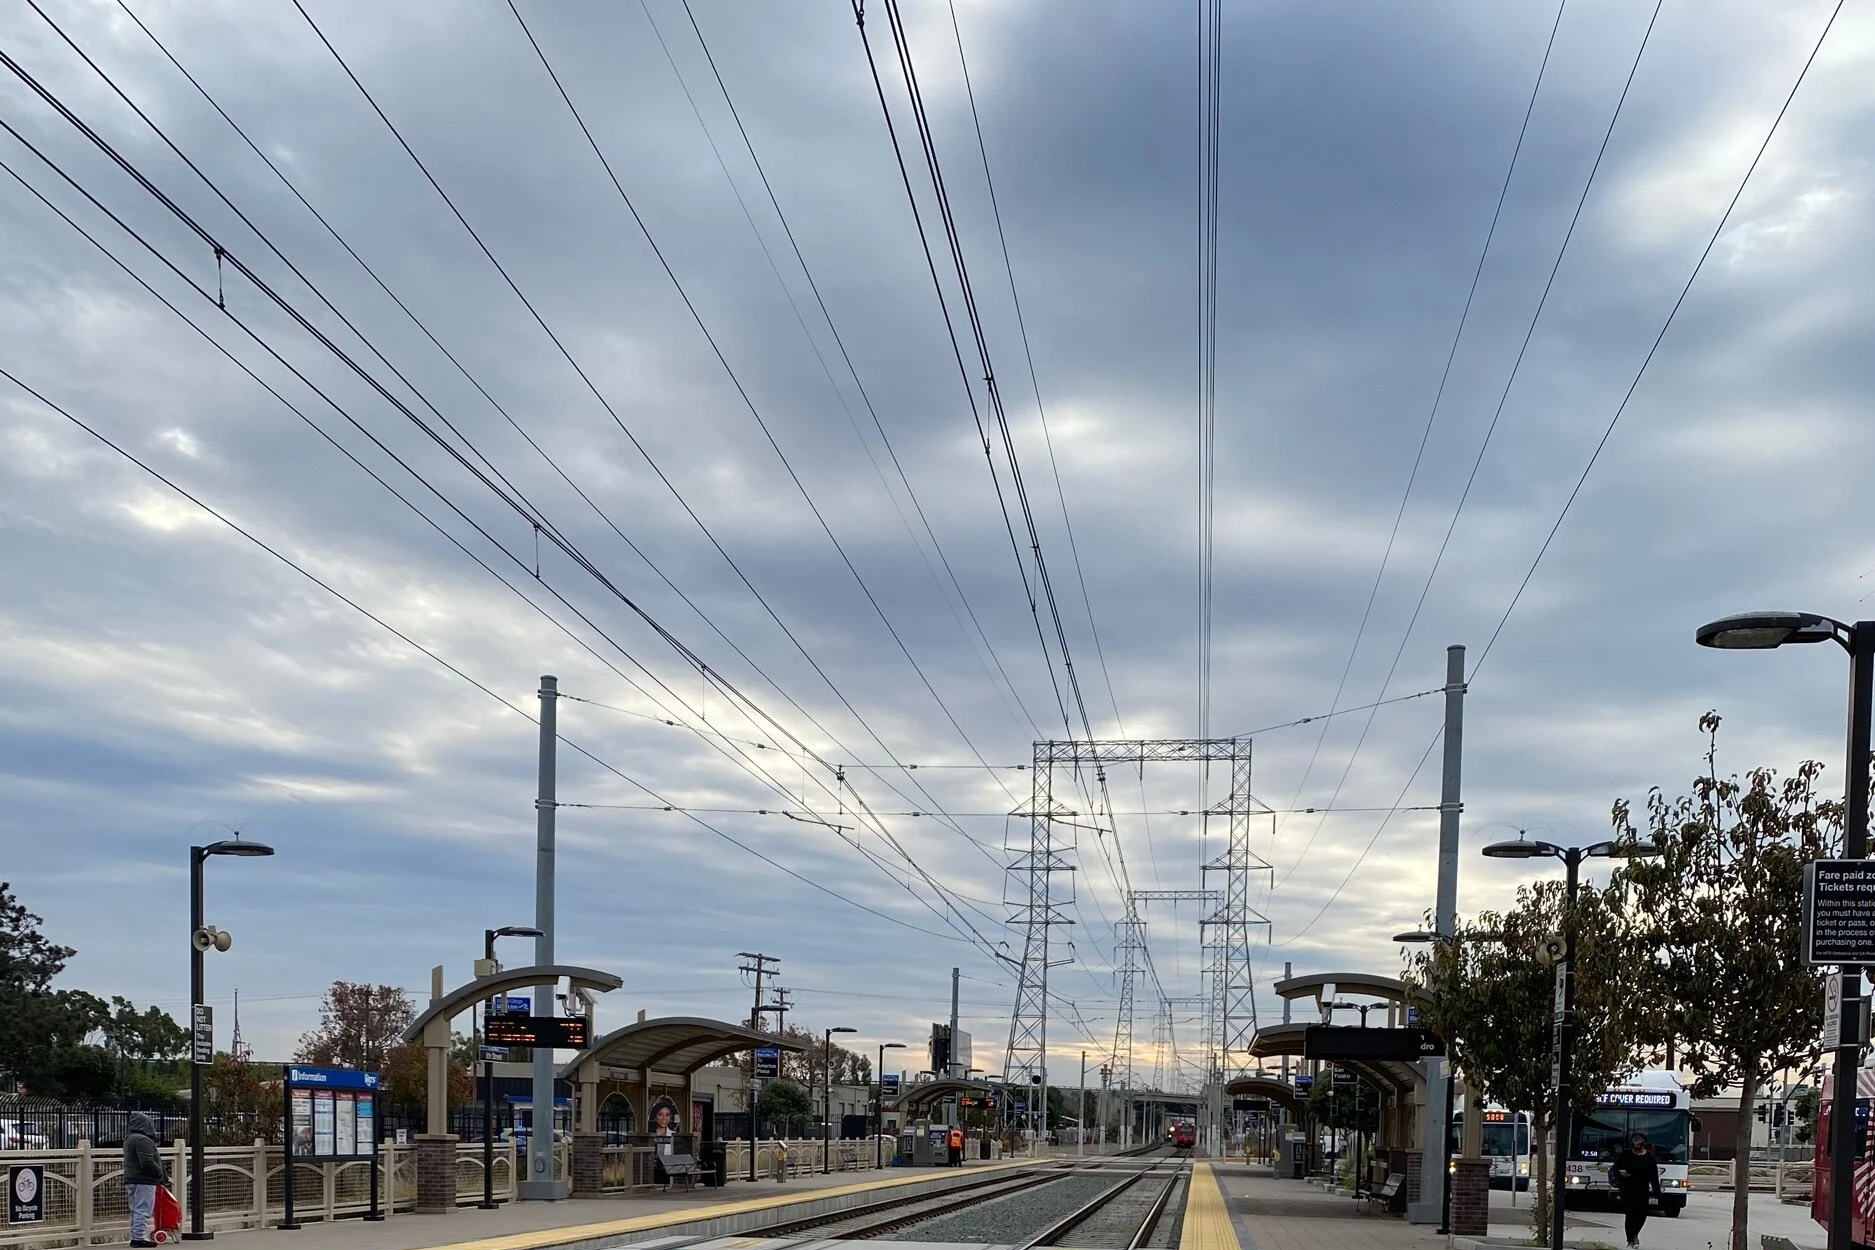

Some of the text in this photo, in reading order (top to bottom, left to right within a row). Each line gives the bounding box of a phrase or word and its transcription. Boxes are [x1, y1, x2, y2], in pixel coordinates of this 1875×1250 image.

[1819, 871, 1840, 880] Fare
[1842, 871, 1864, 881] paid
[1819, 883, 1855, 891] Tickets
[1816, 938, 1857, 947] purchasing
[298, 1072, 327, 1081] Information
[1635, 1095, 1671, 1105] REQUIRED
